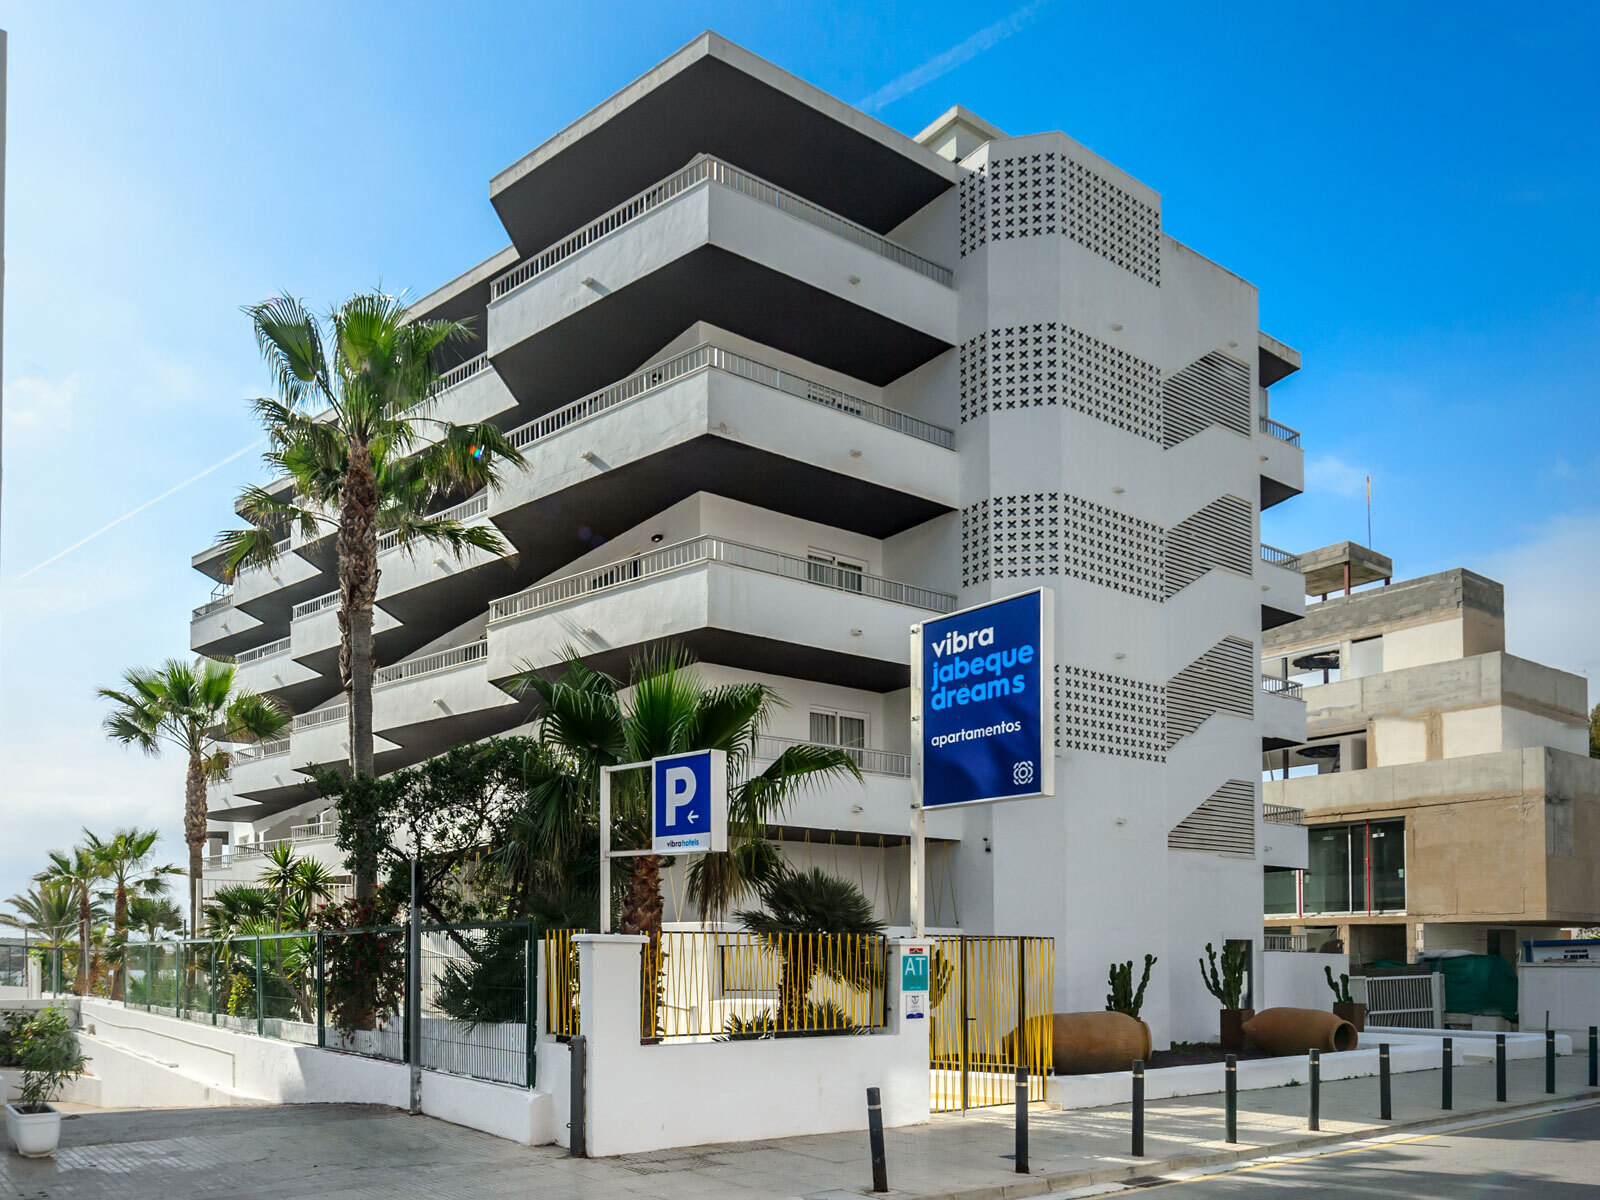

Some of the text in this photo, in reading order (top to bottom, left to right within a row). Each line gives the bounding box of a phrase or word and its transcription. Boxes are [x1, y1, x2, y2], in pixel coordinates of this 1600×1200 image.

[931, 626, 994, 658] vibra
[931, 644, 1034, 692] jabeque
[931, 673, 1025, 711] dreams
[931, 720, 1021, 748] apartamentos
[665, 766, 697, 827] P
[904, 957, 926, 976] AT
